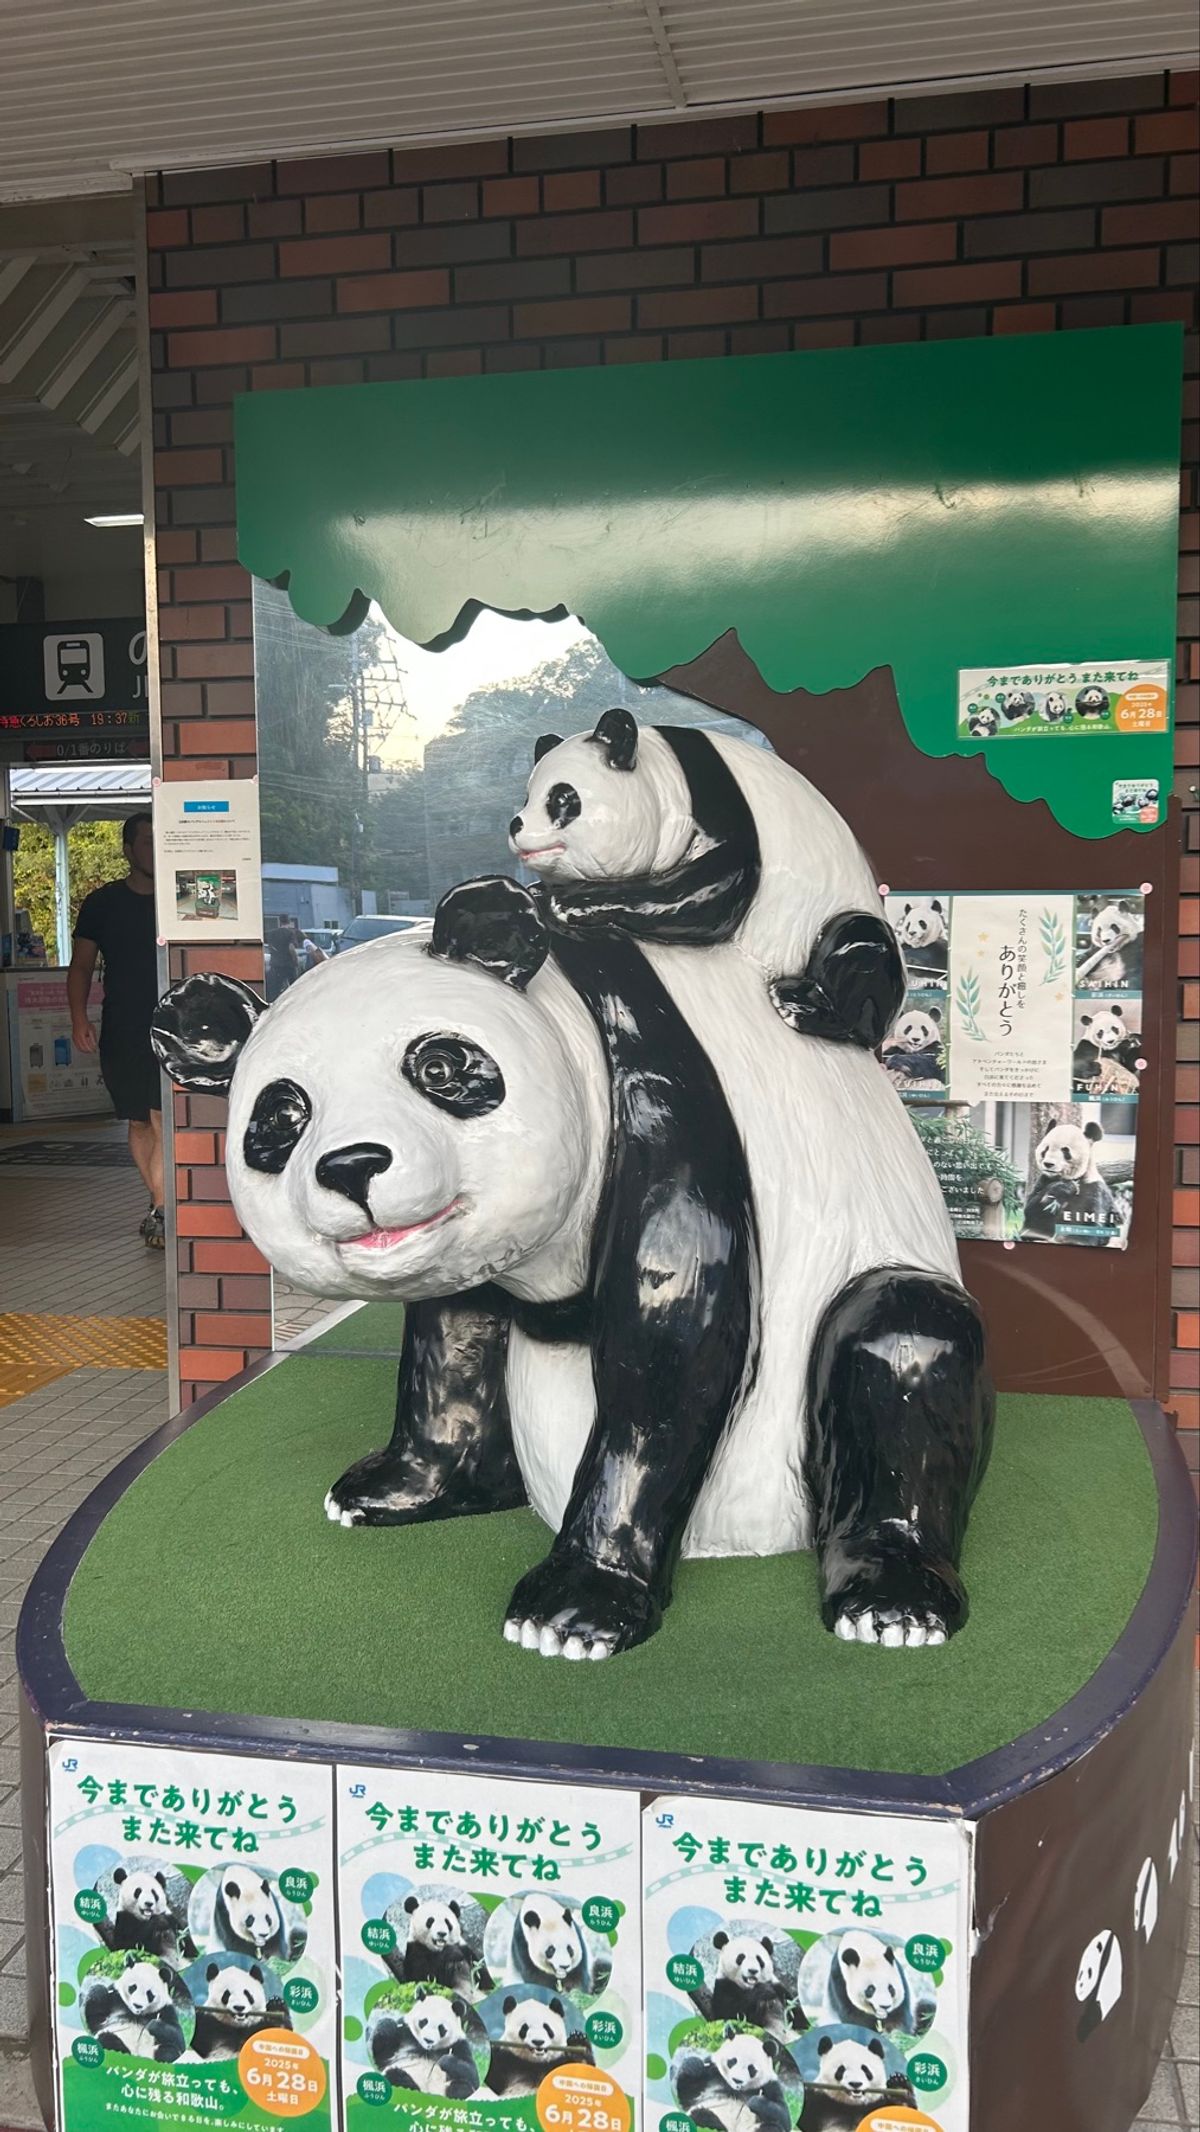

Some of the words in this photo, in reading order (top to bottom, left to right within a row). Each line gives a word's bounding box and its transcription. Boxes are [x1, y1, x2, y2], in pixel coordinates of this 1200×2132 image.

[132, 675, 148, 698] J
[987, 673, 1077, 687] 今までありがとう
[1082, 670, 1139, 684] また来てね
[1120, 708, 1163, 720] 6月28日
[1017, 908, 1028, 1009] たくさんの笑顔と癒しを
[998, 945, 1016, 1037] ありがとう
[1063, 1211, 1114, 1223] EIMEI
[77, 1775, 298, 1824] 今までありがとう
[121, 1816, 259, 1854] また来てね
[365, 1801, 602, 1851] 今までありがとう
[413, 1843, 562, 1881] また来てね
[672, 1832, 928, 1887] 今までありがとう
[723, 1876, 882, 1918] また来てね
[264, 2057, 299, 2070] 2025年
[106, 2066, 238, 2095] パンダが旅立っても、
[246, 2067, 318, 2093] 6月28日
[121, 2084, 224, 2110] 心に残る和歌山。
[266, 2090, 299, 2105] 土曜日
[564, 2094, 602, 2107] 2025年
[394, 2103, 536, 2132] パンダが旅立っても、
[545, 2104, 622, 2131] 6月28日
